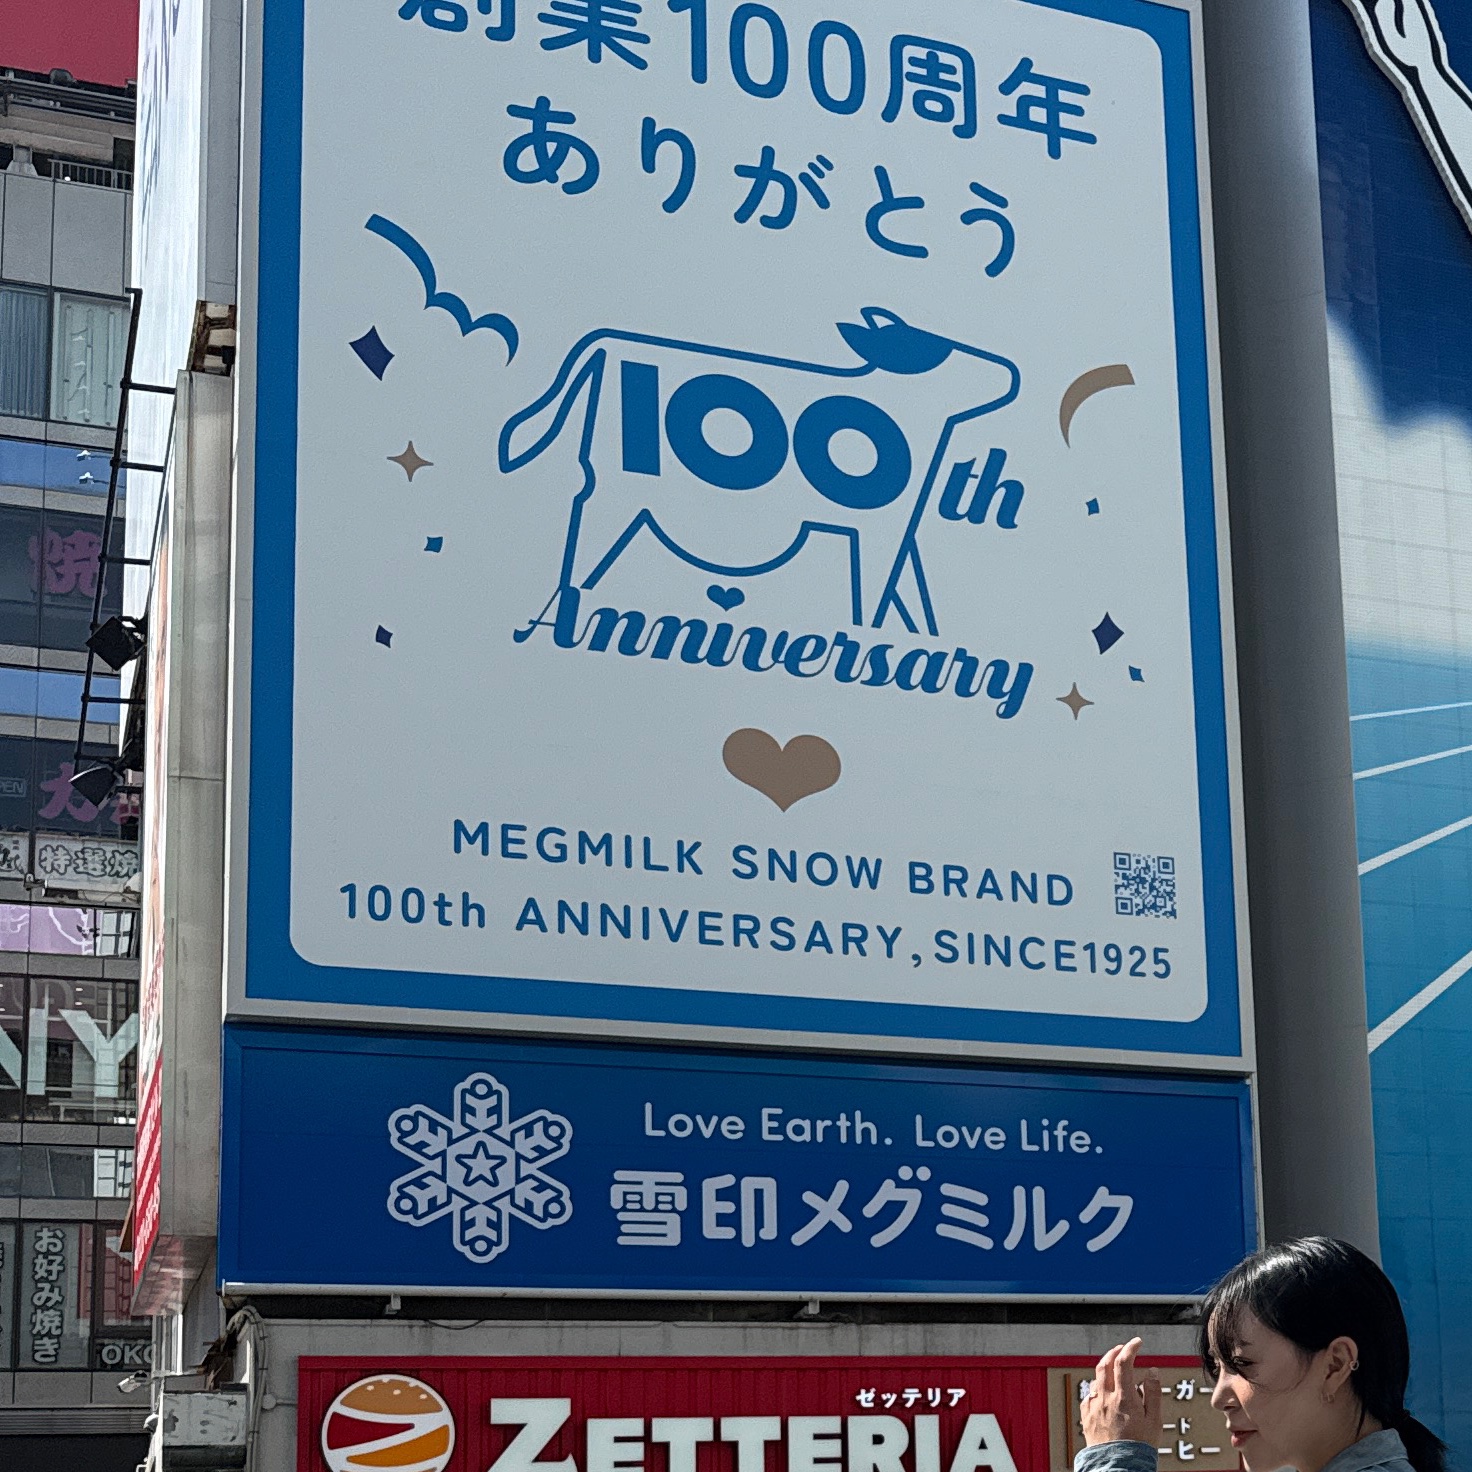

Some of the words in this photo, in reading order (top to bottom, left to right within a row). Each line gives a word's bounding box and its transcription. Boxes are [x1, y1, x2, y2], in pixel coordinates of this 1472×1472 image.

[502, 95, 1016, 278] ありがとう
[513, 585, 1034, 720] Anniversary
[340, 882, 486, 928] 100th
[454, 819, 704, 876] MEGMILK
[733, 844, 884, 890] SNOW
[909, 861, 1074, 907] BRAND
[644, 1102, 745, 1140] Love
[761, 1109, 893, 1146] Earth.
[915, 1115, 1006, 1151] Love
[1020, 1119, 1105, 1154] Life.
[610, 1166, 1135, 1252] 雪印メグミルク
[30, 1227, 66, 1364] お好み焼き
[855, 1387, 967, 1409] ゼッテリア
